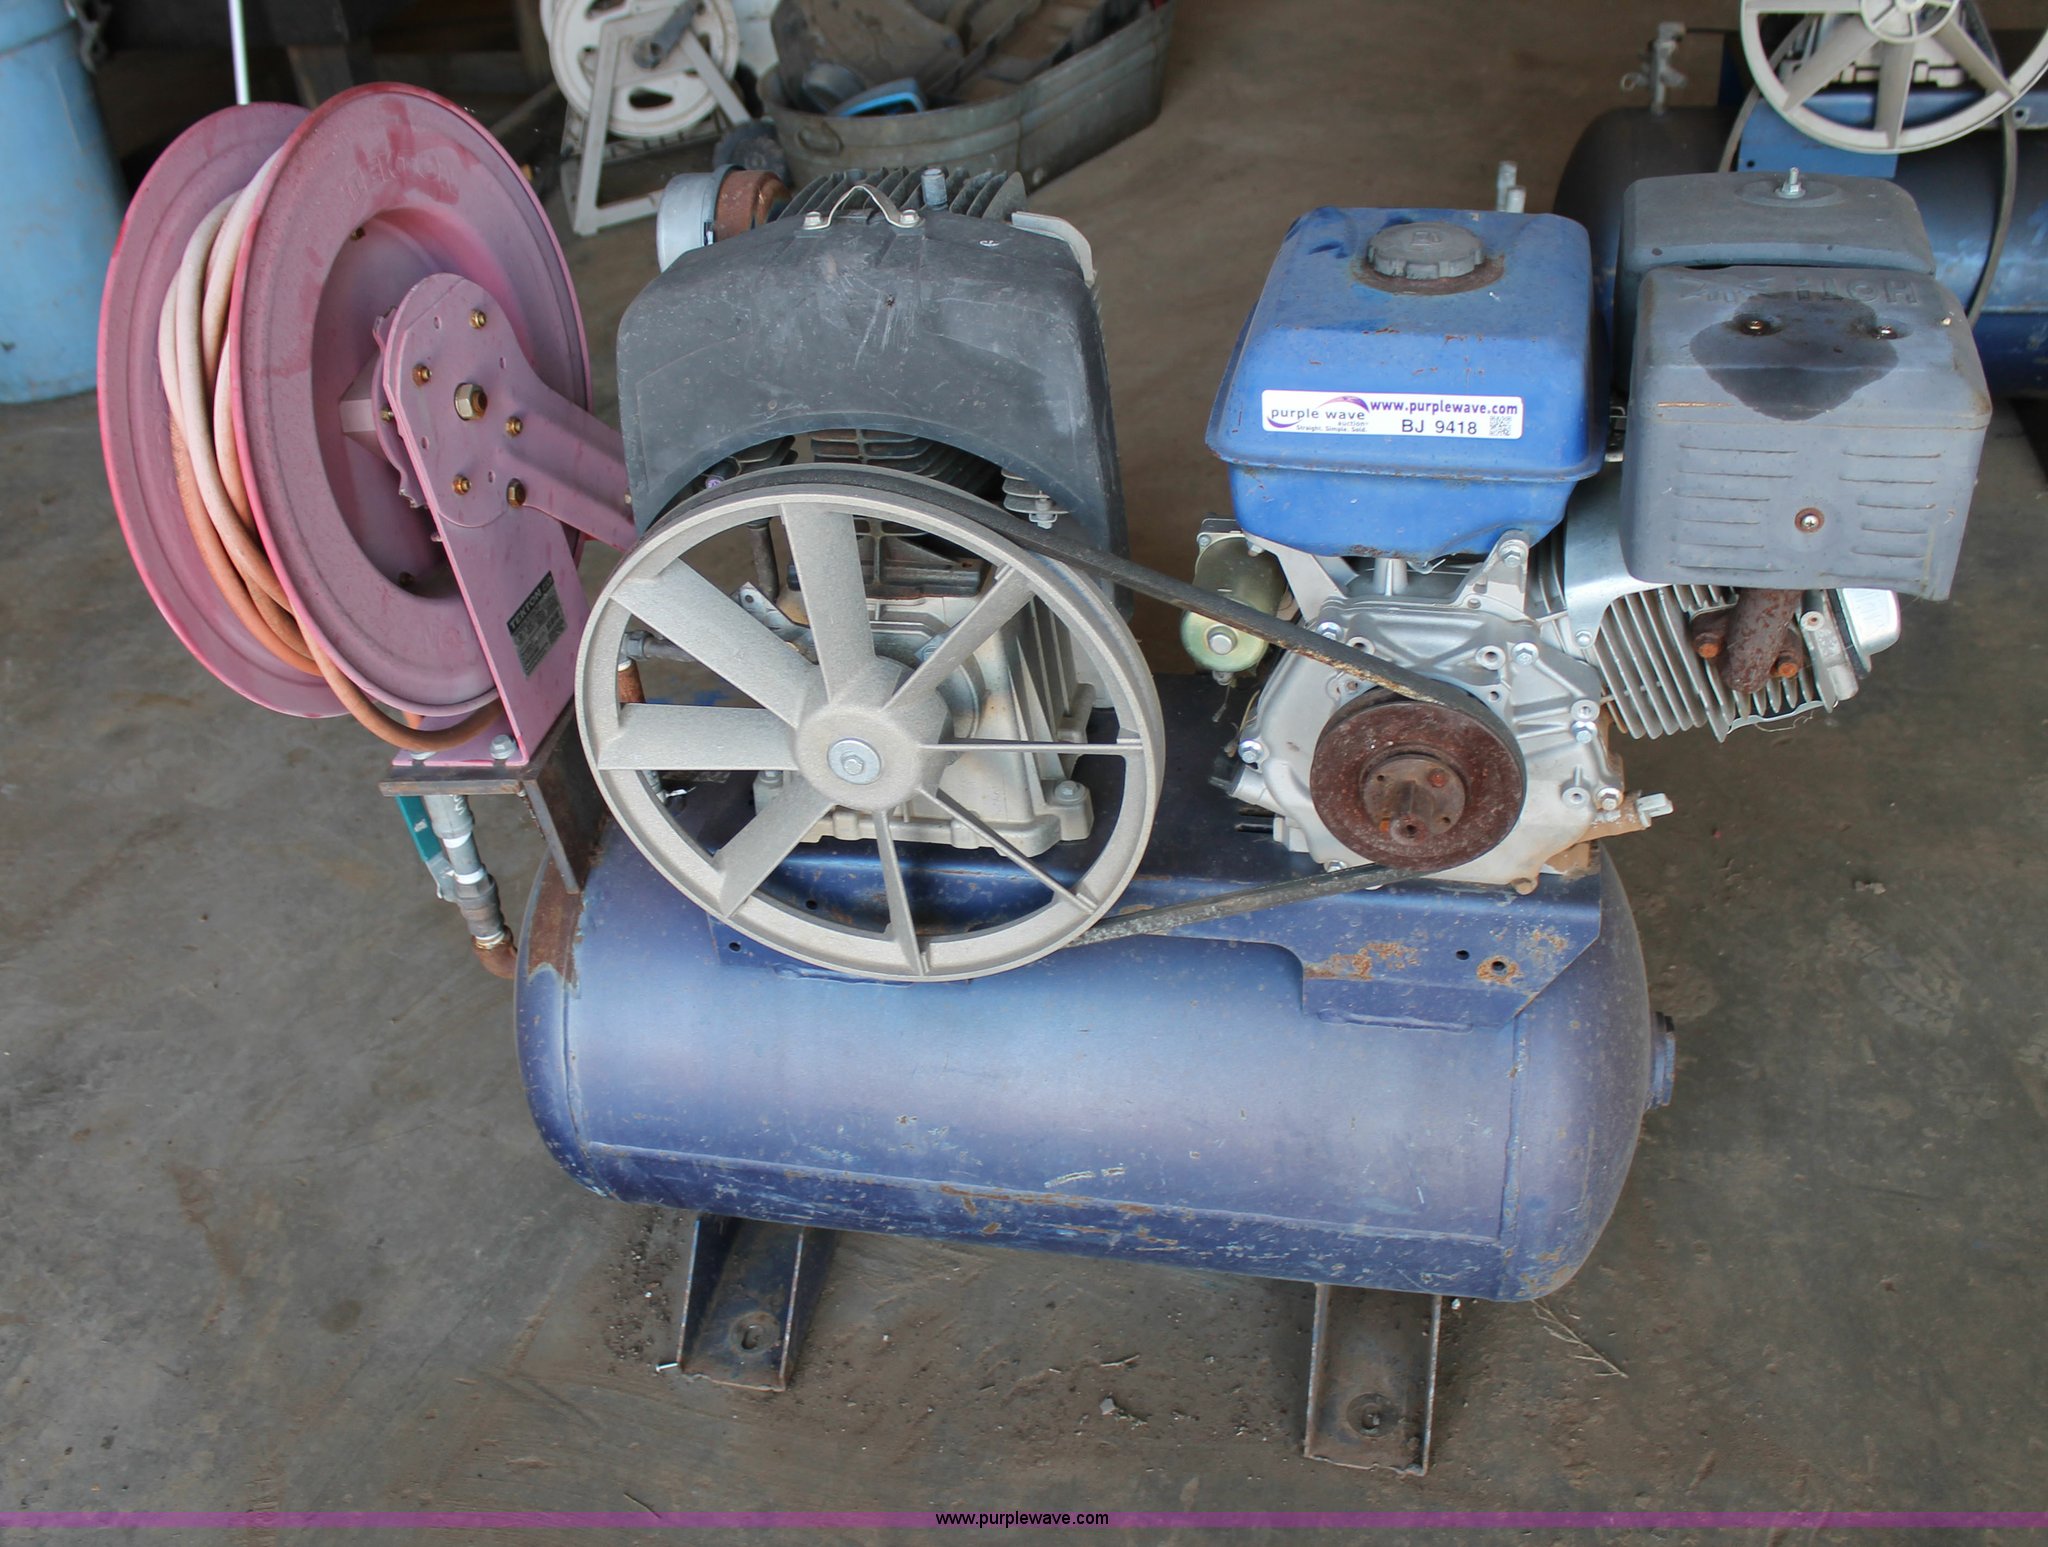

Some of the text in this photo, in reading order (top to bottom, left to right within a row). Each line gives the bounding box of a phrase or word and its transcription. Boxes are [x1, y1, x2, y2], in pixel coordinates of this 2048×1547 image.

[1271, 408, 1365, 420] purple wave
[1370, 400, 1518, 416] www.purplewave.com
[1401, 419, 1478, 435] BJ 9418
